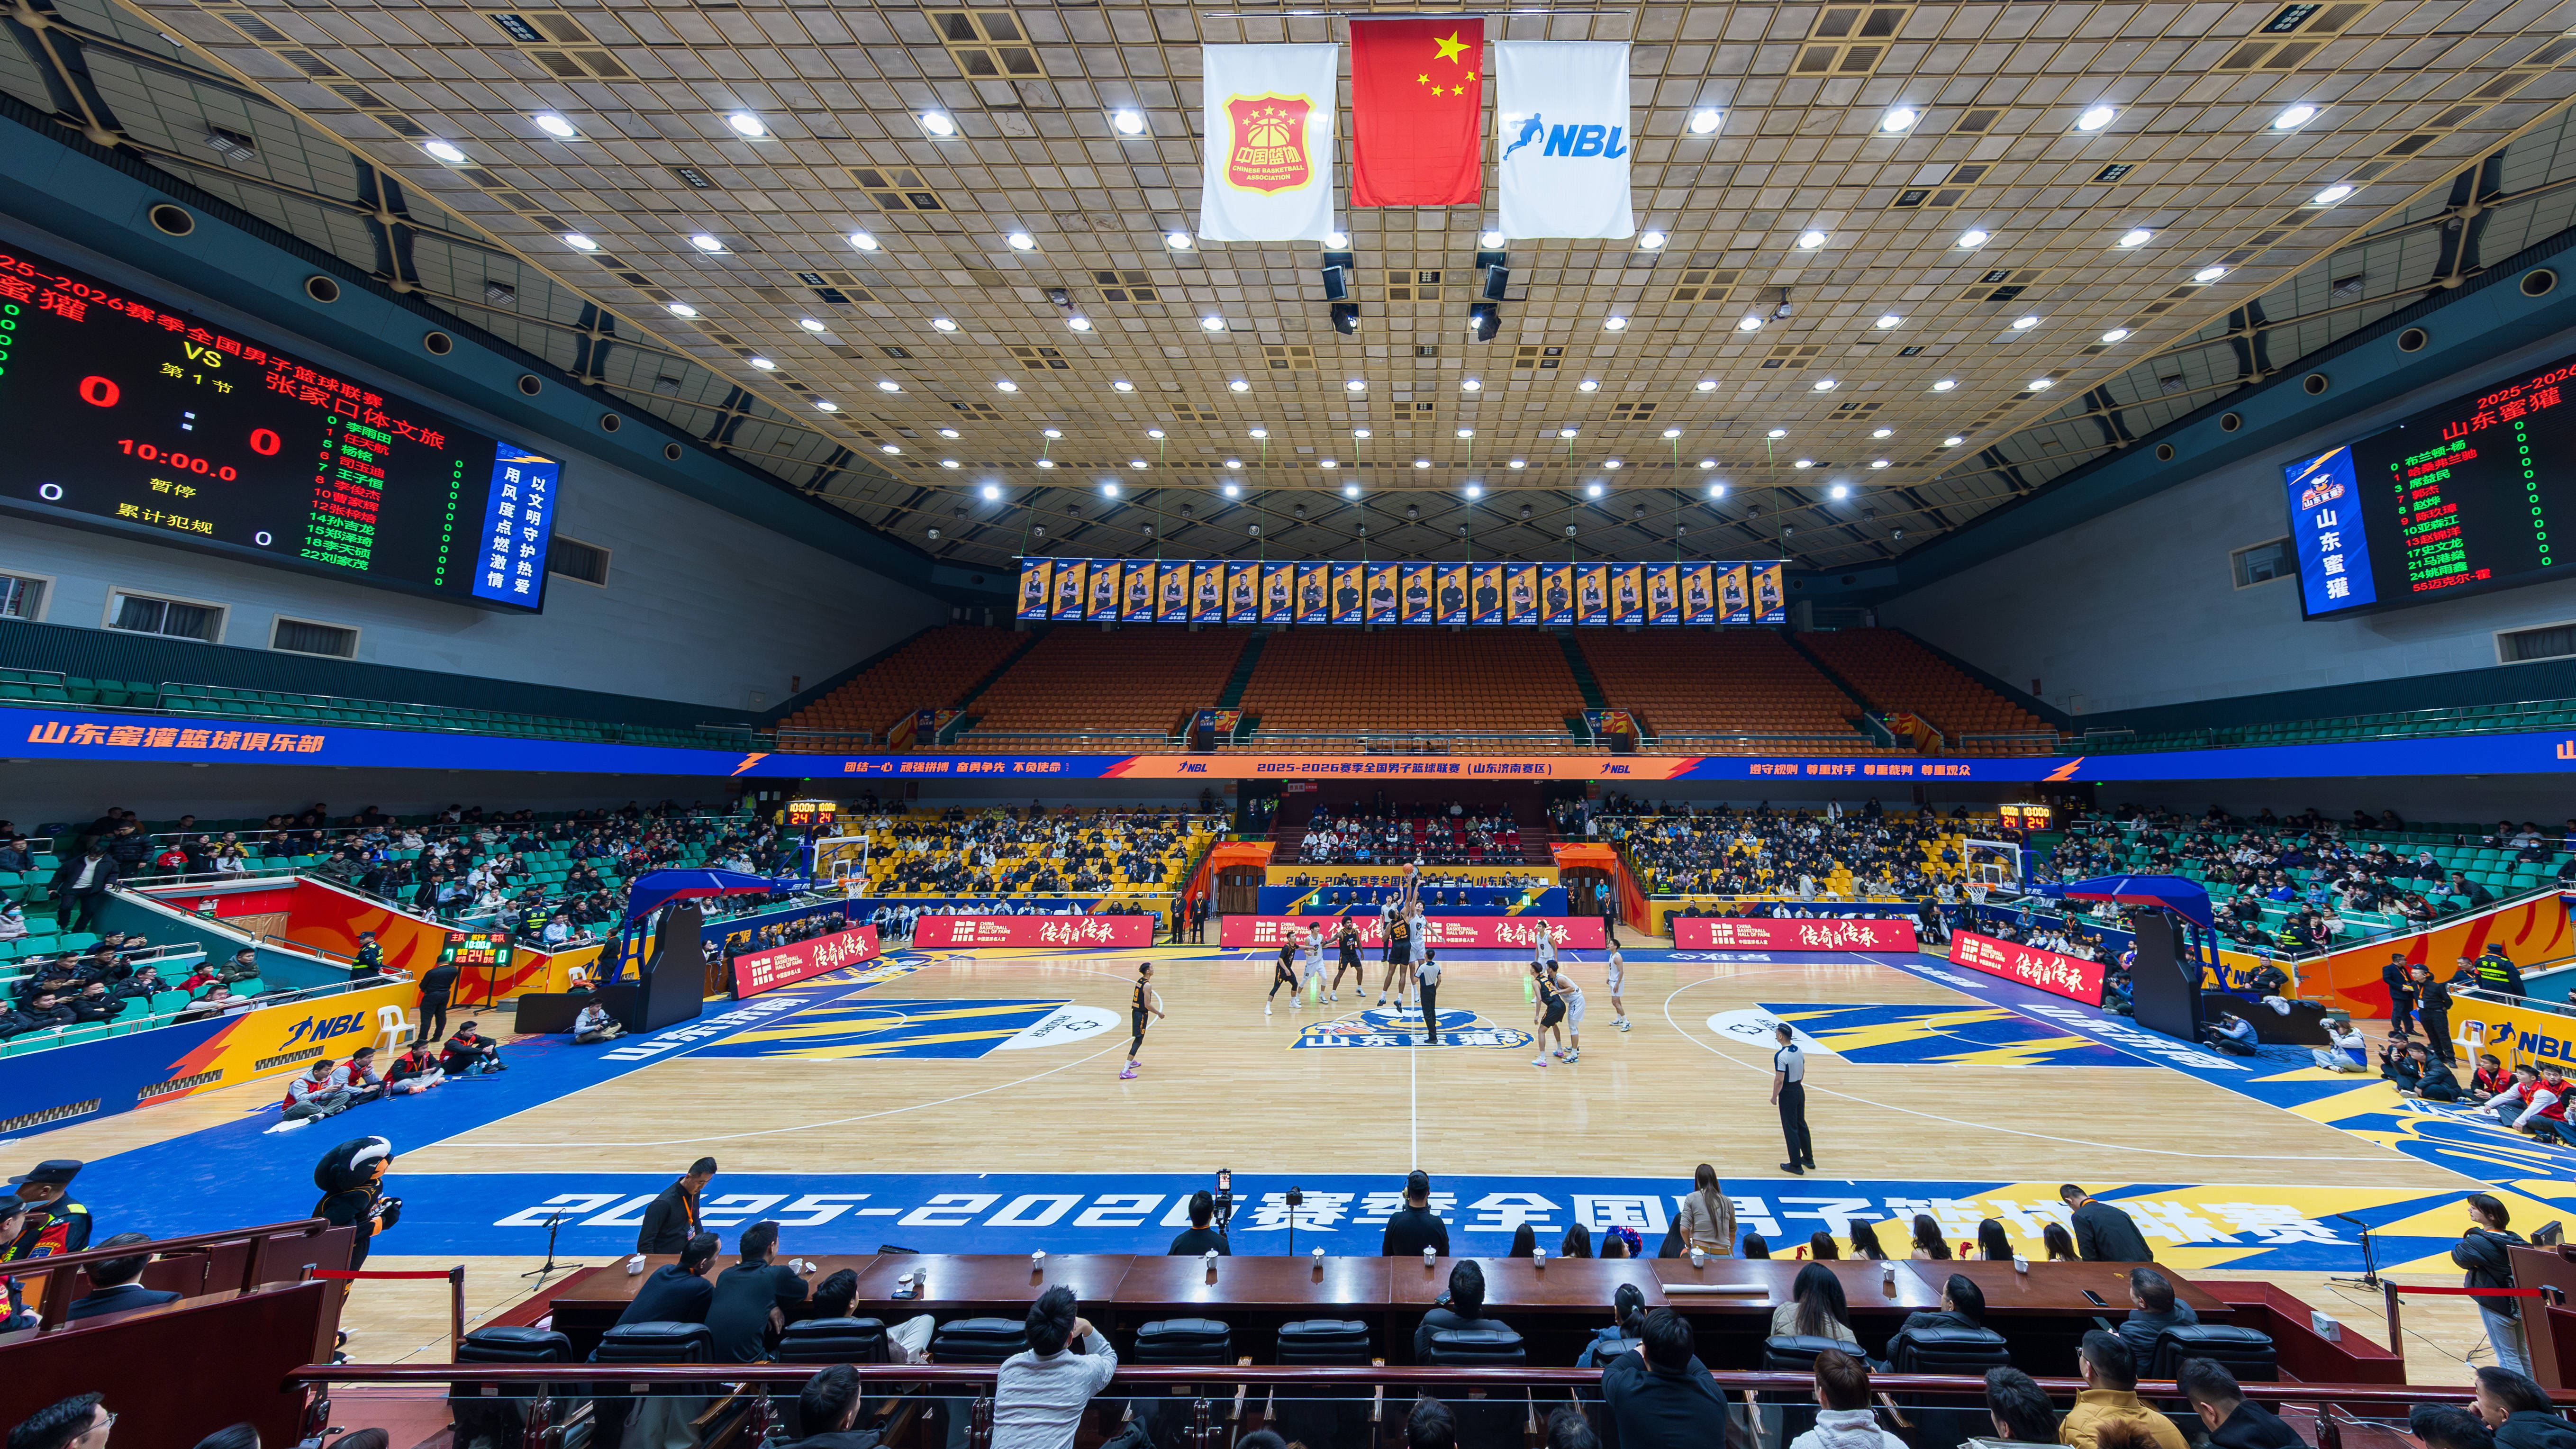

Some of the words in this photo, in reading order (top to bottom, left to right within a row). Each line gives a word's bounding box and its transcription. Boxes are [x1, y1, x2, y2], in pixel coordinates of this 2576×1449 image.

[1544, 124, 1627, 159] NBL
[1235, 146, 1303, 165] 中国篮协
[1232, 164, 1261, 174] CHINESE
[1262, 164, 1305, 174] BASKETBALL
[1246, 172, 1291, 181] ASSOCIATION
[183, 341, 222, 368] VS
[80, 375, 119, 408] 0
[250, 428, 281, 455] 0
[266, 371, 444, 450] 张家口体文旅
[2443, 386, 2562, 441] 山东蜜獾
[345, 421, 391, 444] 李雨田
[341, 444, 373, 462] 杨铭
[343, 433, 390, 455] 任天航
[118, 439, 236, 481] 10:00.0
[339, 456, 384, 479] 司玉迪
[150, 478, 196, 498] 暂停
[336, 468, 384, 489] 王子恒
[2410, 469, 2450, 489] 席益民
[39, 483, 63, 500] 0
[334, 480, 381, 501] 李俊杰
[116, 503, 213, 534] 累计犯规
[487, 467, 520, 589] 用风度点燃激情
[255, 531, 272, 545] 0
[514, 476, 546, 594] 以文明守护热爱
[2316, 508, 2350, 599] 山东蜜獾
[27, 721, 325, 753] 山东蜜獾篮球俱乐部
[844, 761, 893, 773] 团结一心
[900, 761, 949, 773] 顽强拼搏
[957, 761, 1005, 773] 奋勇争先
[1013, 761, 1061, 773] 不负使命
[1187, 763, 1207, 773] NBL
[1611, 765, 1630, 774] NBL
[1750, 764, 1797, 775] 遵守规则
[1806, 764, 1856, 776] 尊重对手
[1864, 764, 1913, 776] 尊重裁判
[1921, 764, 1970, 776] 尊重观众
[791, 813, 808, 824] 24
[819, 812, 831, 824] 24
[2003, 815, 2015, 827] 24
[2027, 817, 2044, 829] 24
[451, 933, 465, 942] 主队
[491, 934, 505, 942] 客队
[1394, 924, 1406, 937] 55
[468, 949, 483, 962] 24
[498, 950, 507, 962] 0
[774, 955, 799, 965] BASKETBALL
[1700, 953, 1771, 961] 准者
[309, 1011, 365, 1042] NBL
[598, 997, 811, 1061] 山东济南
[1029, 1015, 1072, 1037] RIGORER
[2518, 1031, 2576, 1063] NBL
